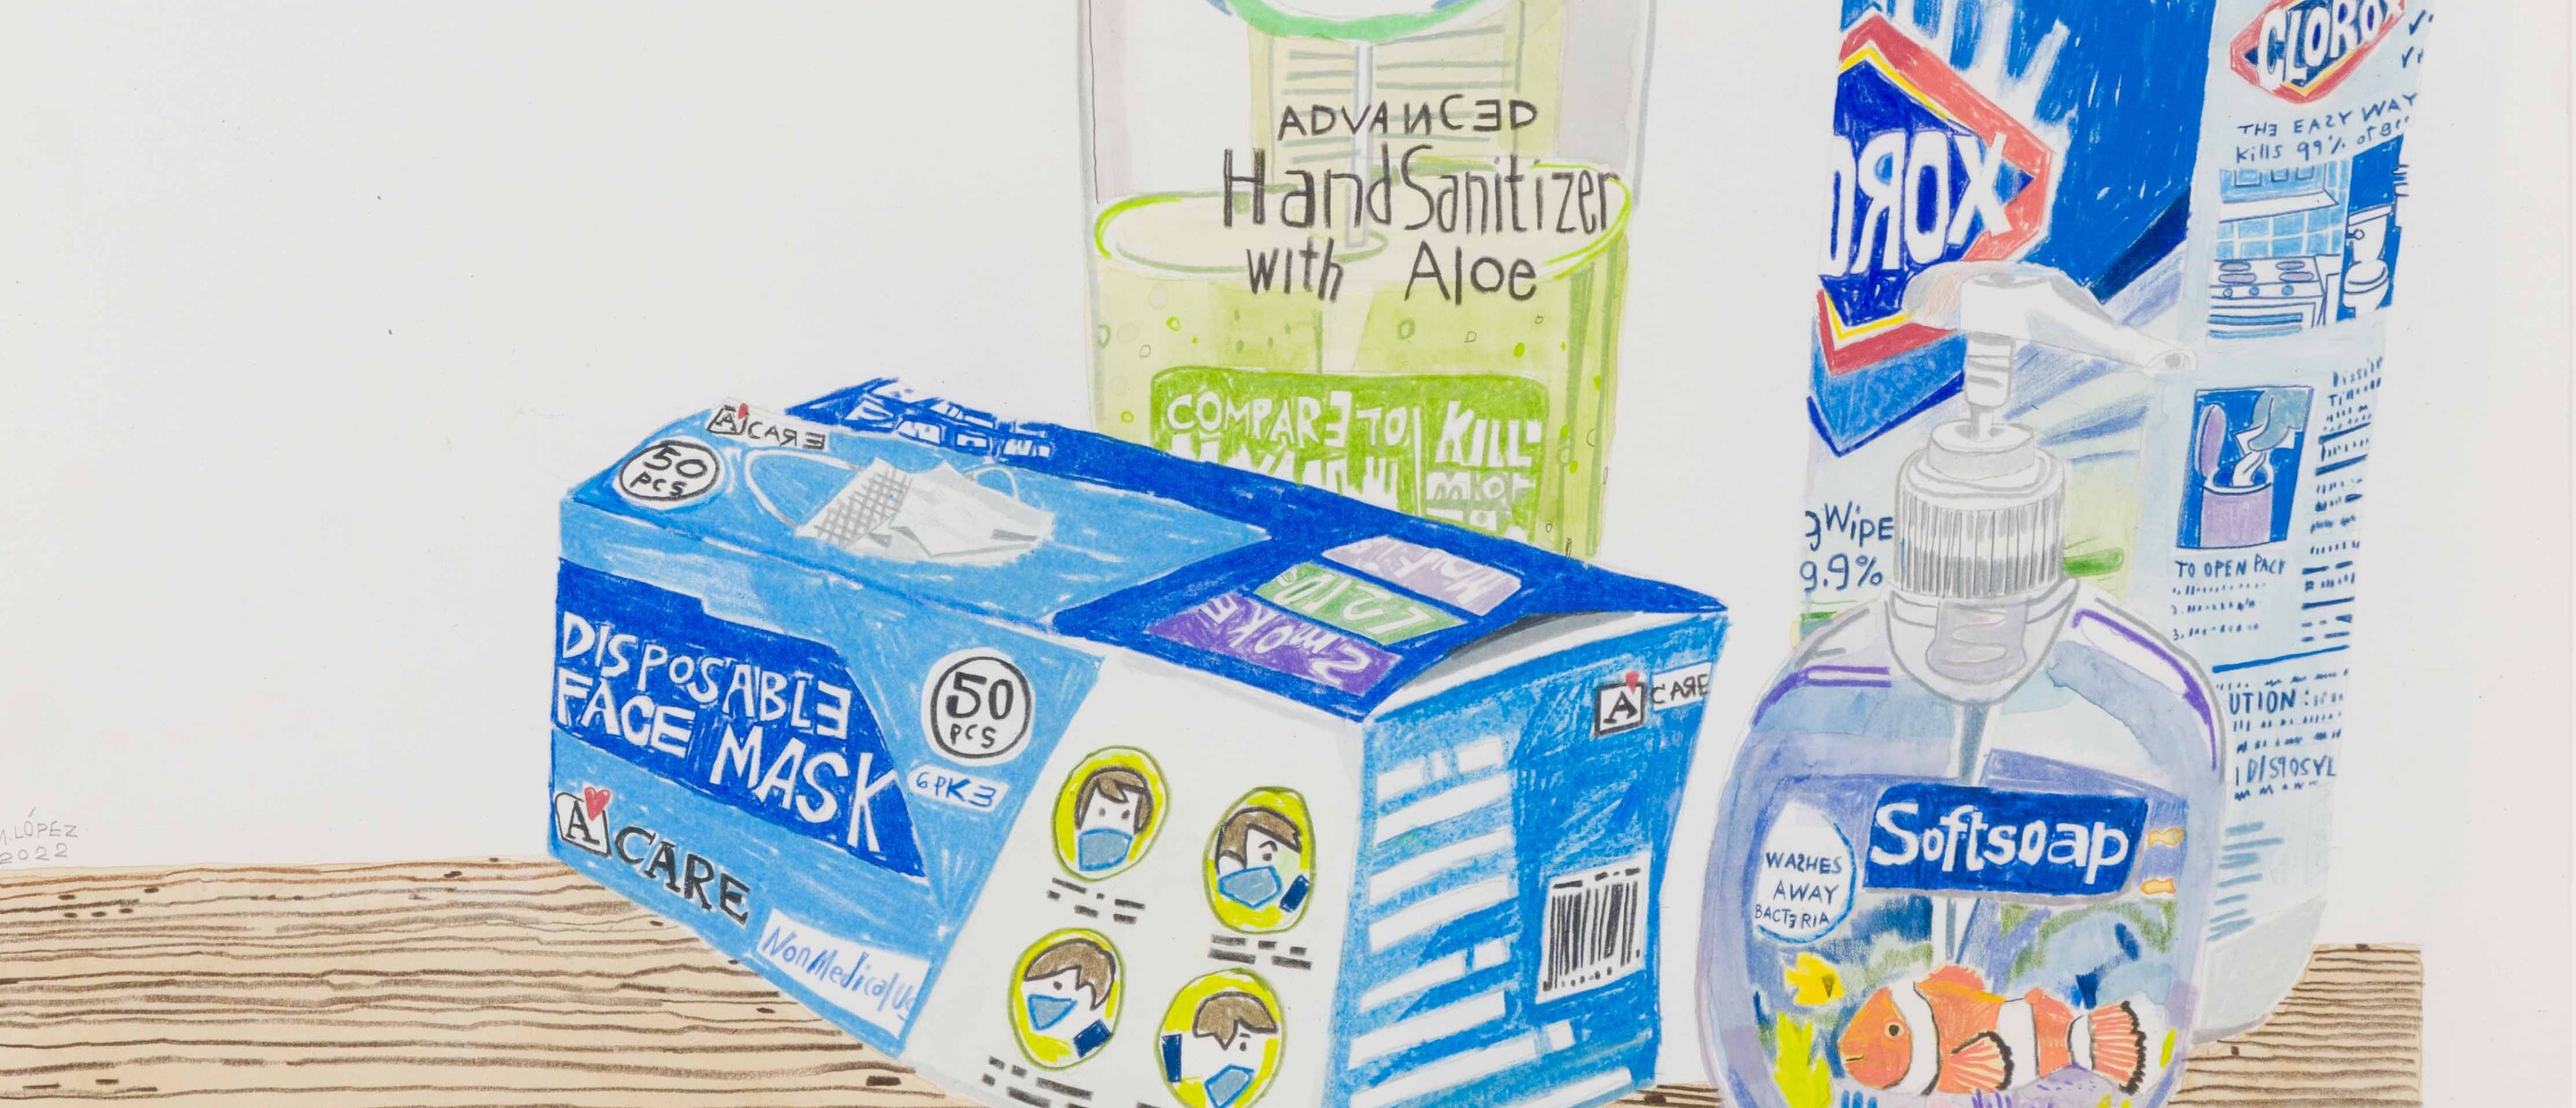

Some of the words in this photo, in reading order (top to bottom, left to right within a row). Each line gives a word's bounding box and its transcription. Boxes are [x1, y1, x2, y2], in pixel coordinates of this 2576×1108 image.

[1277, 94, 1537, 141] ADVANCED
[2237, 122, 2277, 137] THE
[2361, 92, 2418, 122] WAY
[1247, 238, 1344, 302] with
[1404, 240, 1537, 306] Aloe
[747, 420, 827, 450] CARE
[1167, 390, 1352, 448] COMPARE
[1357, 406, 1409, 447] TO
[644, 447, 707, 479] 50
[2175, 560, 2195, 578] TO
[2204, 559, 2247, 578] OPEN
[561, 611, 852, 741] DISPOSABLE
[946, 672, 1014, 720] 50
[1650, 673, 1711, 705] CARE
[557, 667, 695, 760] FACE
[709, 725, 897, 852] MASK
[0, 842, 69, 864] 2022
[565, 800, 601, 845] A
[614, 825, 751, 927] CARE
[1871, 802, 2128, 885] Softsoap
[1772, 879, 1840, 905] AWAY
[1755, 903, 1831, 929] BACTERIA
